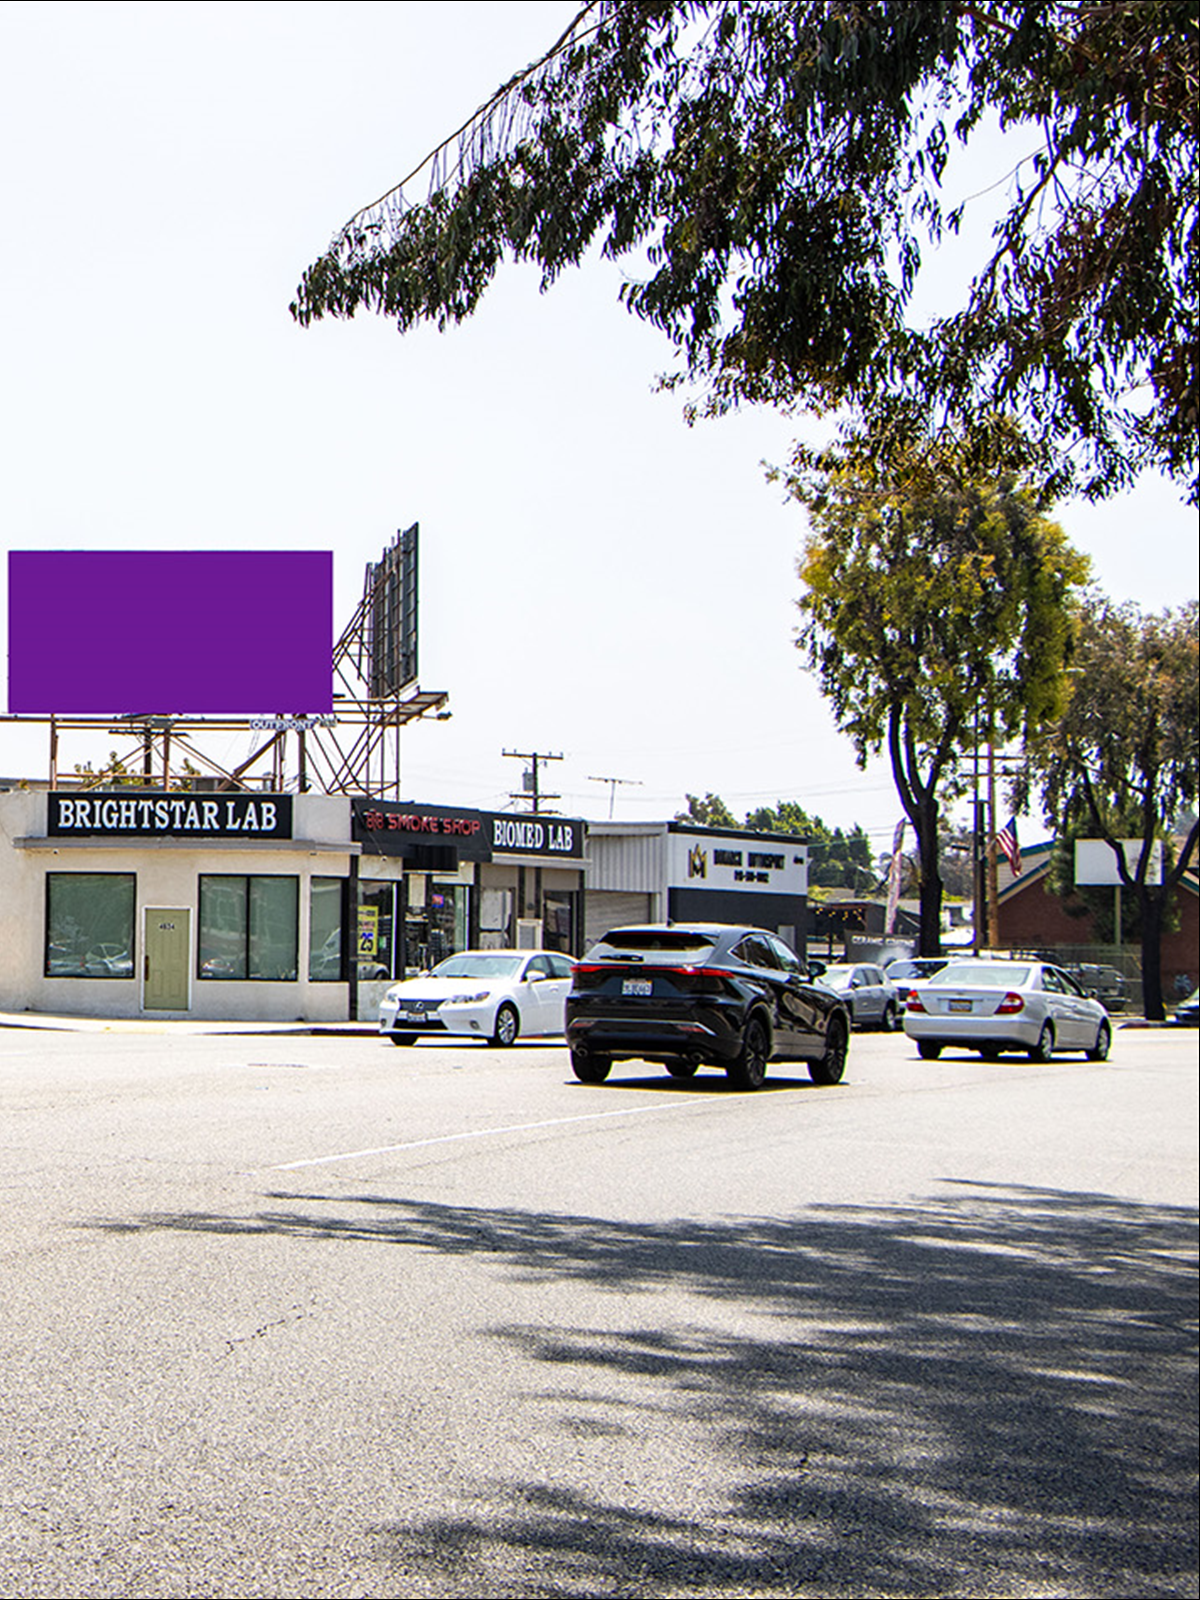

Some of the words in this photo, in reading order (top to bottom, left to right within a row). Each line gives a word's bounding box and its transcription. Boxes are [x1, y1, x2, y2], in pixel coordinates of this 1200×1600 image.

[58, 799, 220, 830] BRIGHTSTAR
[225, 801, 278, 831] LAB
[387, 813, 439, 832] SMOKE
[443, 817, 481, 835] SHOP
[493, 819, 544, 849] BIOMED
[548, 824, 574, 852] LAB
[360, 931, 374, 952] 25
